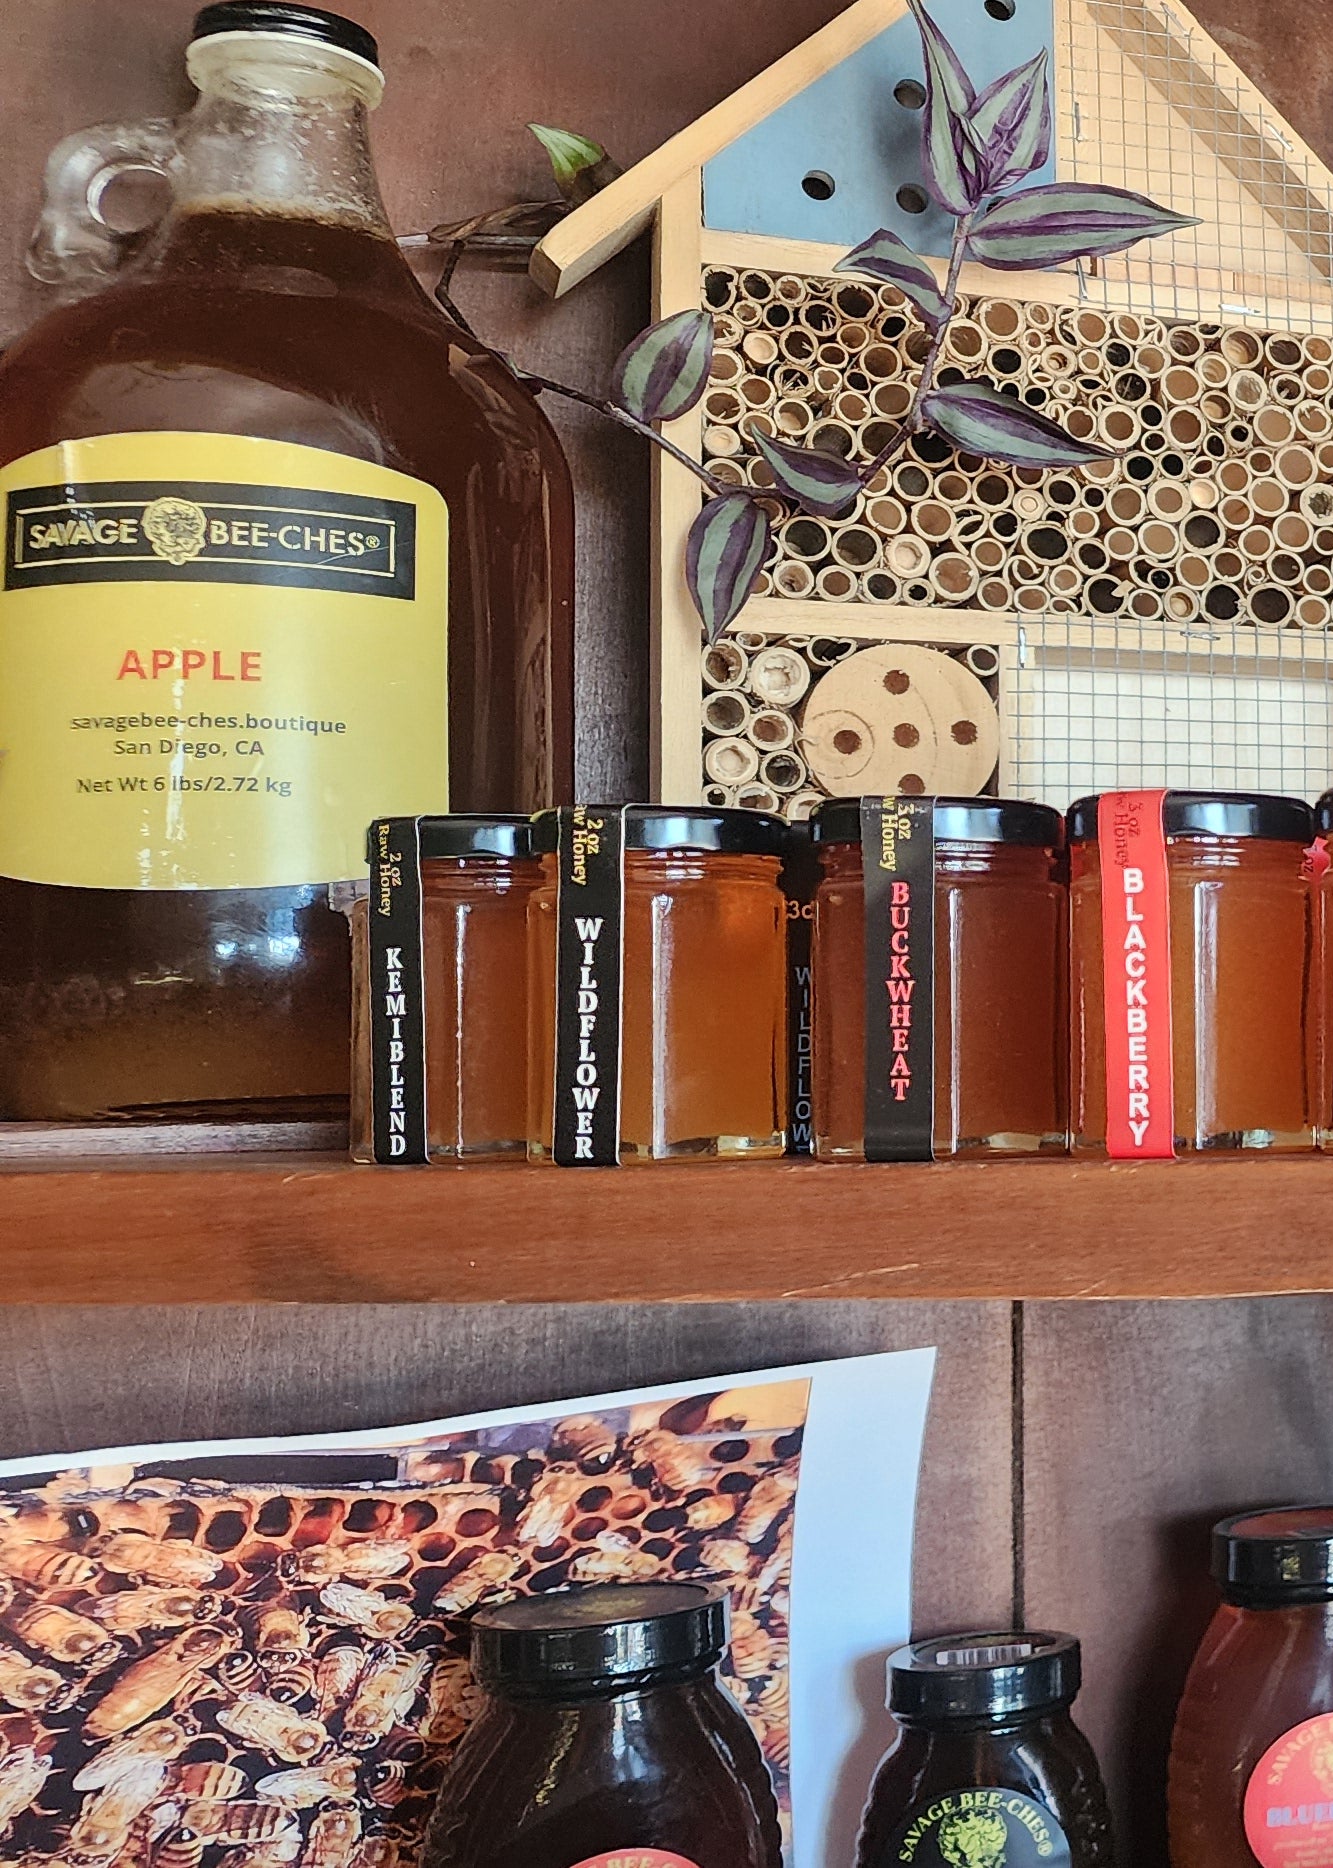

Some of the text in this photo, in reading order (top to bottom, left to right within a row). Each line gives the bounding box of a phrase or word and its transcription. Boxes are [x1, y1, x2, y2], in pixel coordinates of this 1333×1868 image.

[28, 519, 138, 549] SAVAGE
[116, 650, 263, 681] APPLE
[71, 711, 347, 735] savagebee-ches.boutique
[114, 739, 264, 760] San Diego, CA
[77, 774, 292, 797] Net Wt 6 lbs/2.72 kg
[571, 803, 587, 886] aw Honey
[587, 819, 604, 855] 2 oz
[879, 813, 898, 872] Honey
[898, 803, 915, 840] 3 oz
[378, 823, 390, 917] Raw Honey
[390, 852, 402, 887] 2 oz
[889, 882, 916, 1102] BUCKWHEAT
[1122, 868, 1151, 1147] BLACKBERRY
[385, 948, 407, 1156] KEMIBLEND
[573, 918, 603, 1159] WILDFLOWER
[793, 967, 811, 1152] WILDFLOW
[1267, 1721, 1326, 1785] SAVAGE
[899, 1795, 956, 1863] SAVAGE
